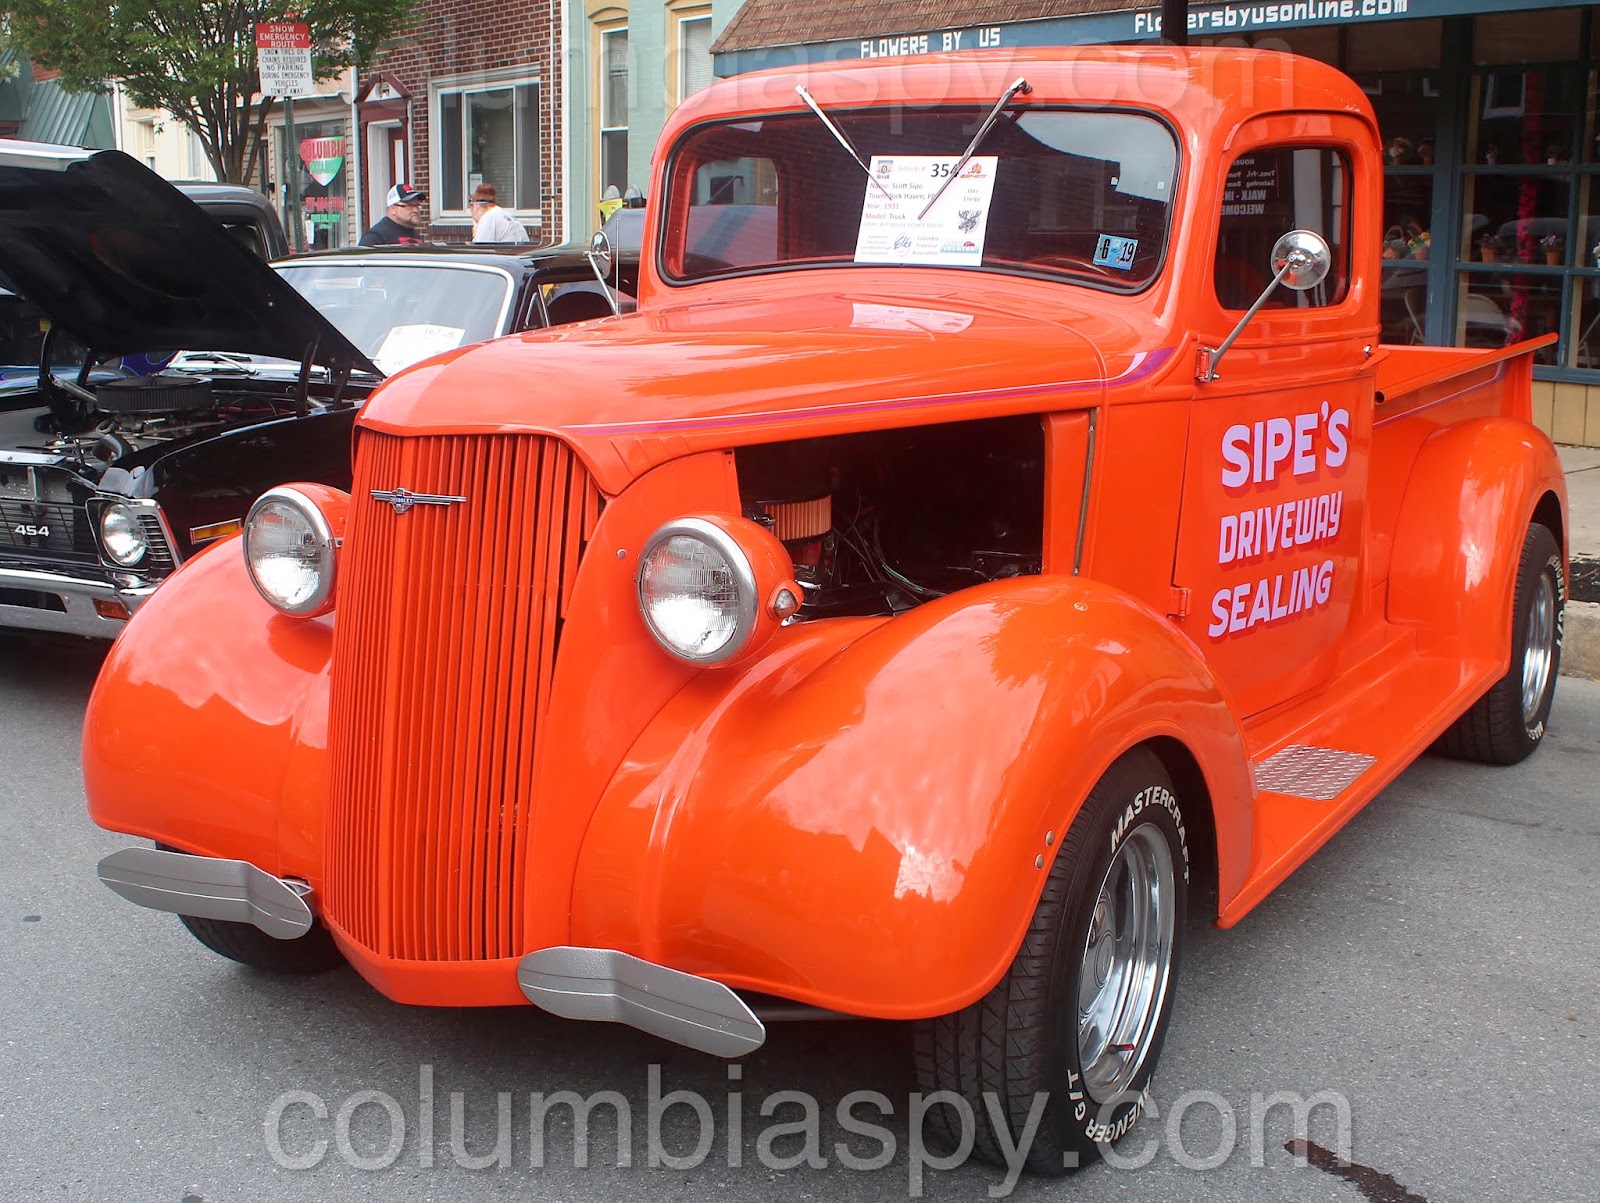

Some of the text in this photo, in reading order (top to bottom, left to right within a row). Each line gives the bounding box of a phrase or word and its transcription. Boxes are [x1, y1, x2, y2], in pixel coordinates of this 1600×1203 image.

[1134, 0, 1408, 33] Floersbyusonline.com
[260, 33, 305, 41] EMERGENCY
[269, 25, 295, 33] SNOW
[270, 40, 296, 48] ROUTE
[860, 27, 1001, 59] FLOWERS BY US
[282, 56, 308, 64] REQUIRED
[300, 139, 347, 160] COLUMBIA
[892, 182, 908, 190] Scott
[909, 182, 923, 190] Sipe
[904, 193, 926, 201] Haven,
[1101, 239, 1135, 262] 6 19
[1221, 400, 1349, 488] SIPE'S
[14, 524, 49, 537] 454
[1218, 490, 1343, 564] DRIVEWAY
[1208, 559, 1334, 638] SEALING
[1111, 786, 1189, 885] MASTERCRAFT
[1085, 1074, 1152, 1143] AVENGER
